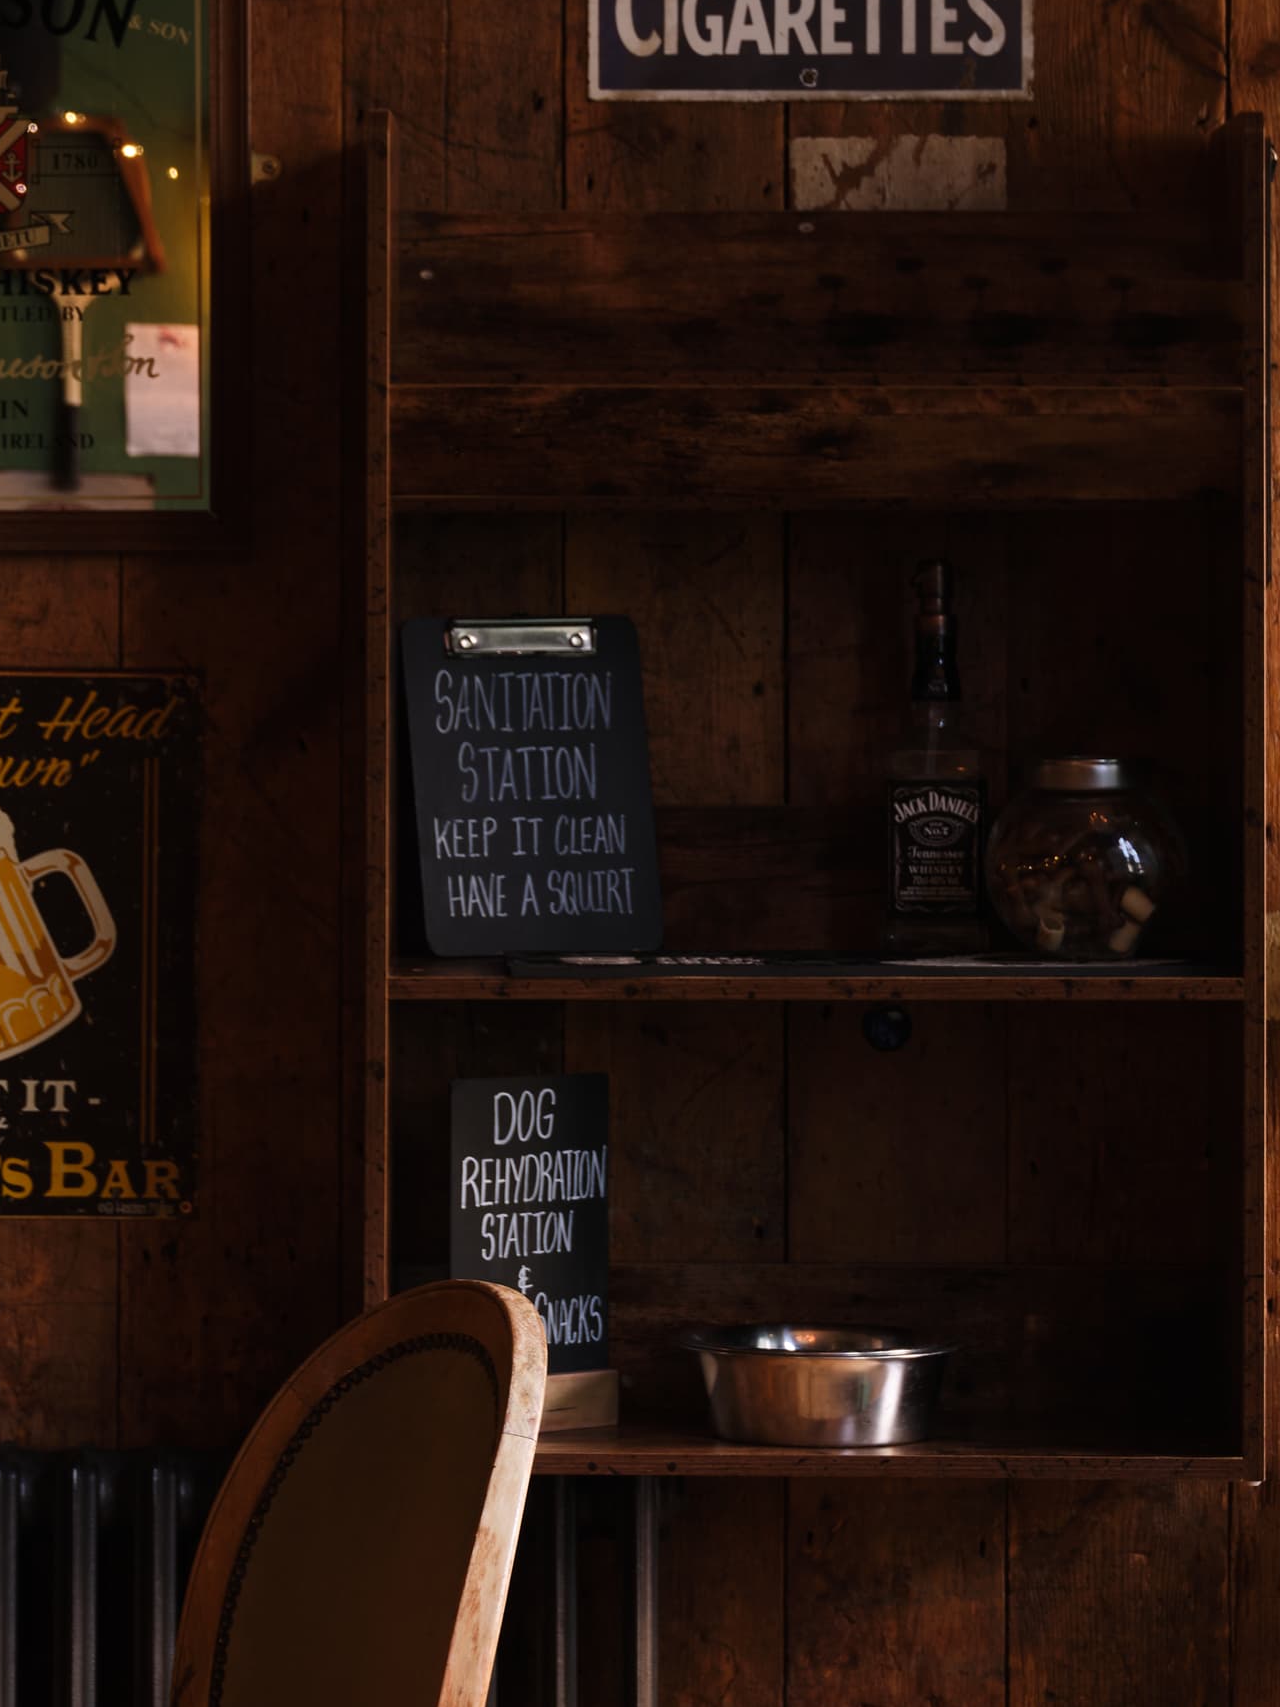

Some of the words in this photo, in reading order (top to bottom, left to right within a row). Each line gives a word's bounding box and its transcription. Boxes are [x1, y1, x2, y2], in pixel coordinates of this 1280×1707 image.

[128, 16, 143, 32] &
[148, 18, 193, 46] SON
[52, 153, 99, 170] 1780
[61, 306, 85, 322] BY
[2, 433, 95, 450] IRELAND
[38, 690, 177, 743] Head
[434, 669, 613, 735] SANITATION
[458, 741, 597, 803] STATION
[893, 797, 928, 823] JACK
[433, 816, 498, 860] KEEP
[512, 816, 544, 856] IT
[554, 813, 626, 856] CLEAN
[447, 872, 509, 918] HAVE
[520, 873, 541, 917] A
[547, 867, 636, 916] SQUIRT
[24, 1078, 78, 1113] IT
[493, 1087, 557, 1146] DOG
[43, 1140, 183, 1200] BAR
[460, 1144, 608, 1210] REHYDRATION
[481, 1209, 574, 1261] STATION
